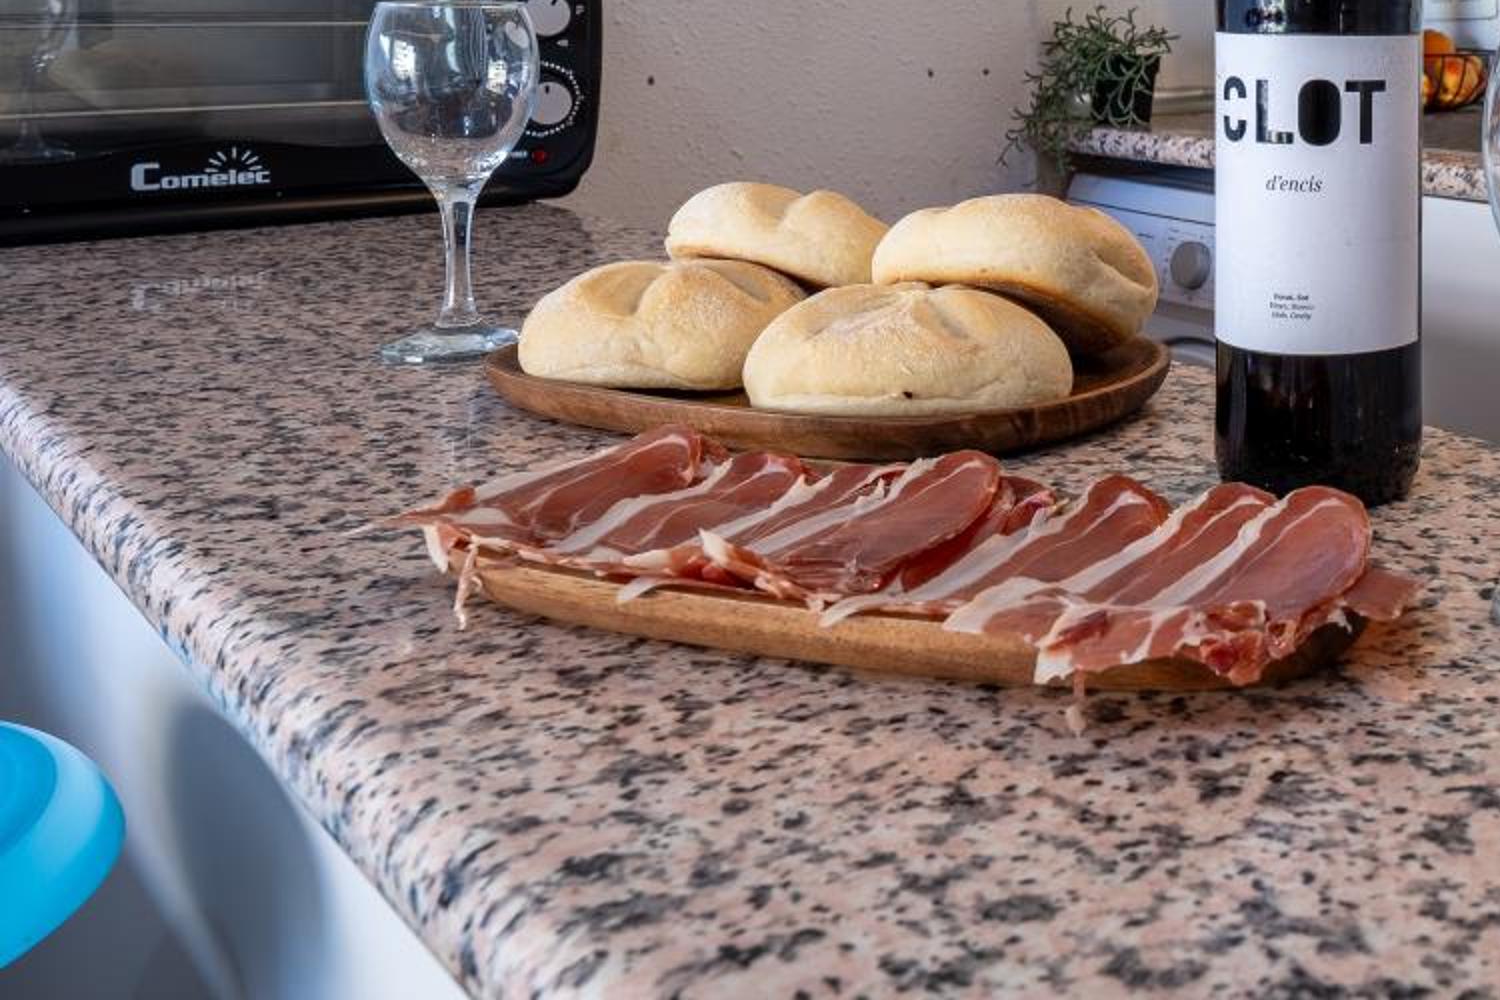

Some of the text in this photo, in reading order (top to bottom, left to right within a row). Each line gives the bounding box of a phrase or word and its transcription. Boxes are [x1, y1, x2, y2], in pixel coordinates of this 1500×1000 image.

[1223, 76, 1386, 146] CLOT
[131, 162, 271, 191] Comelec
[1265, 174, 1323, 193] d'encis
